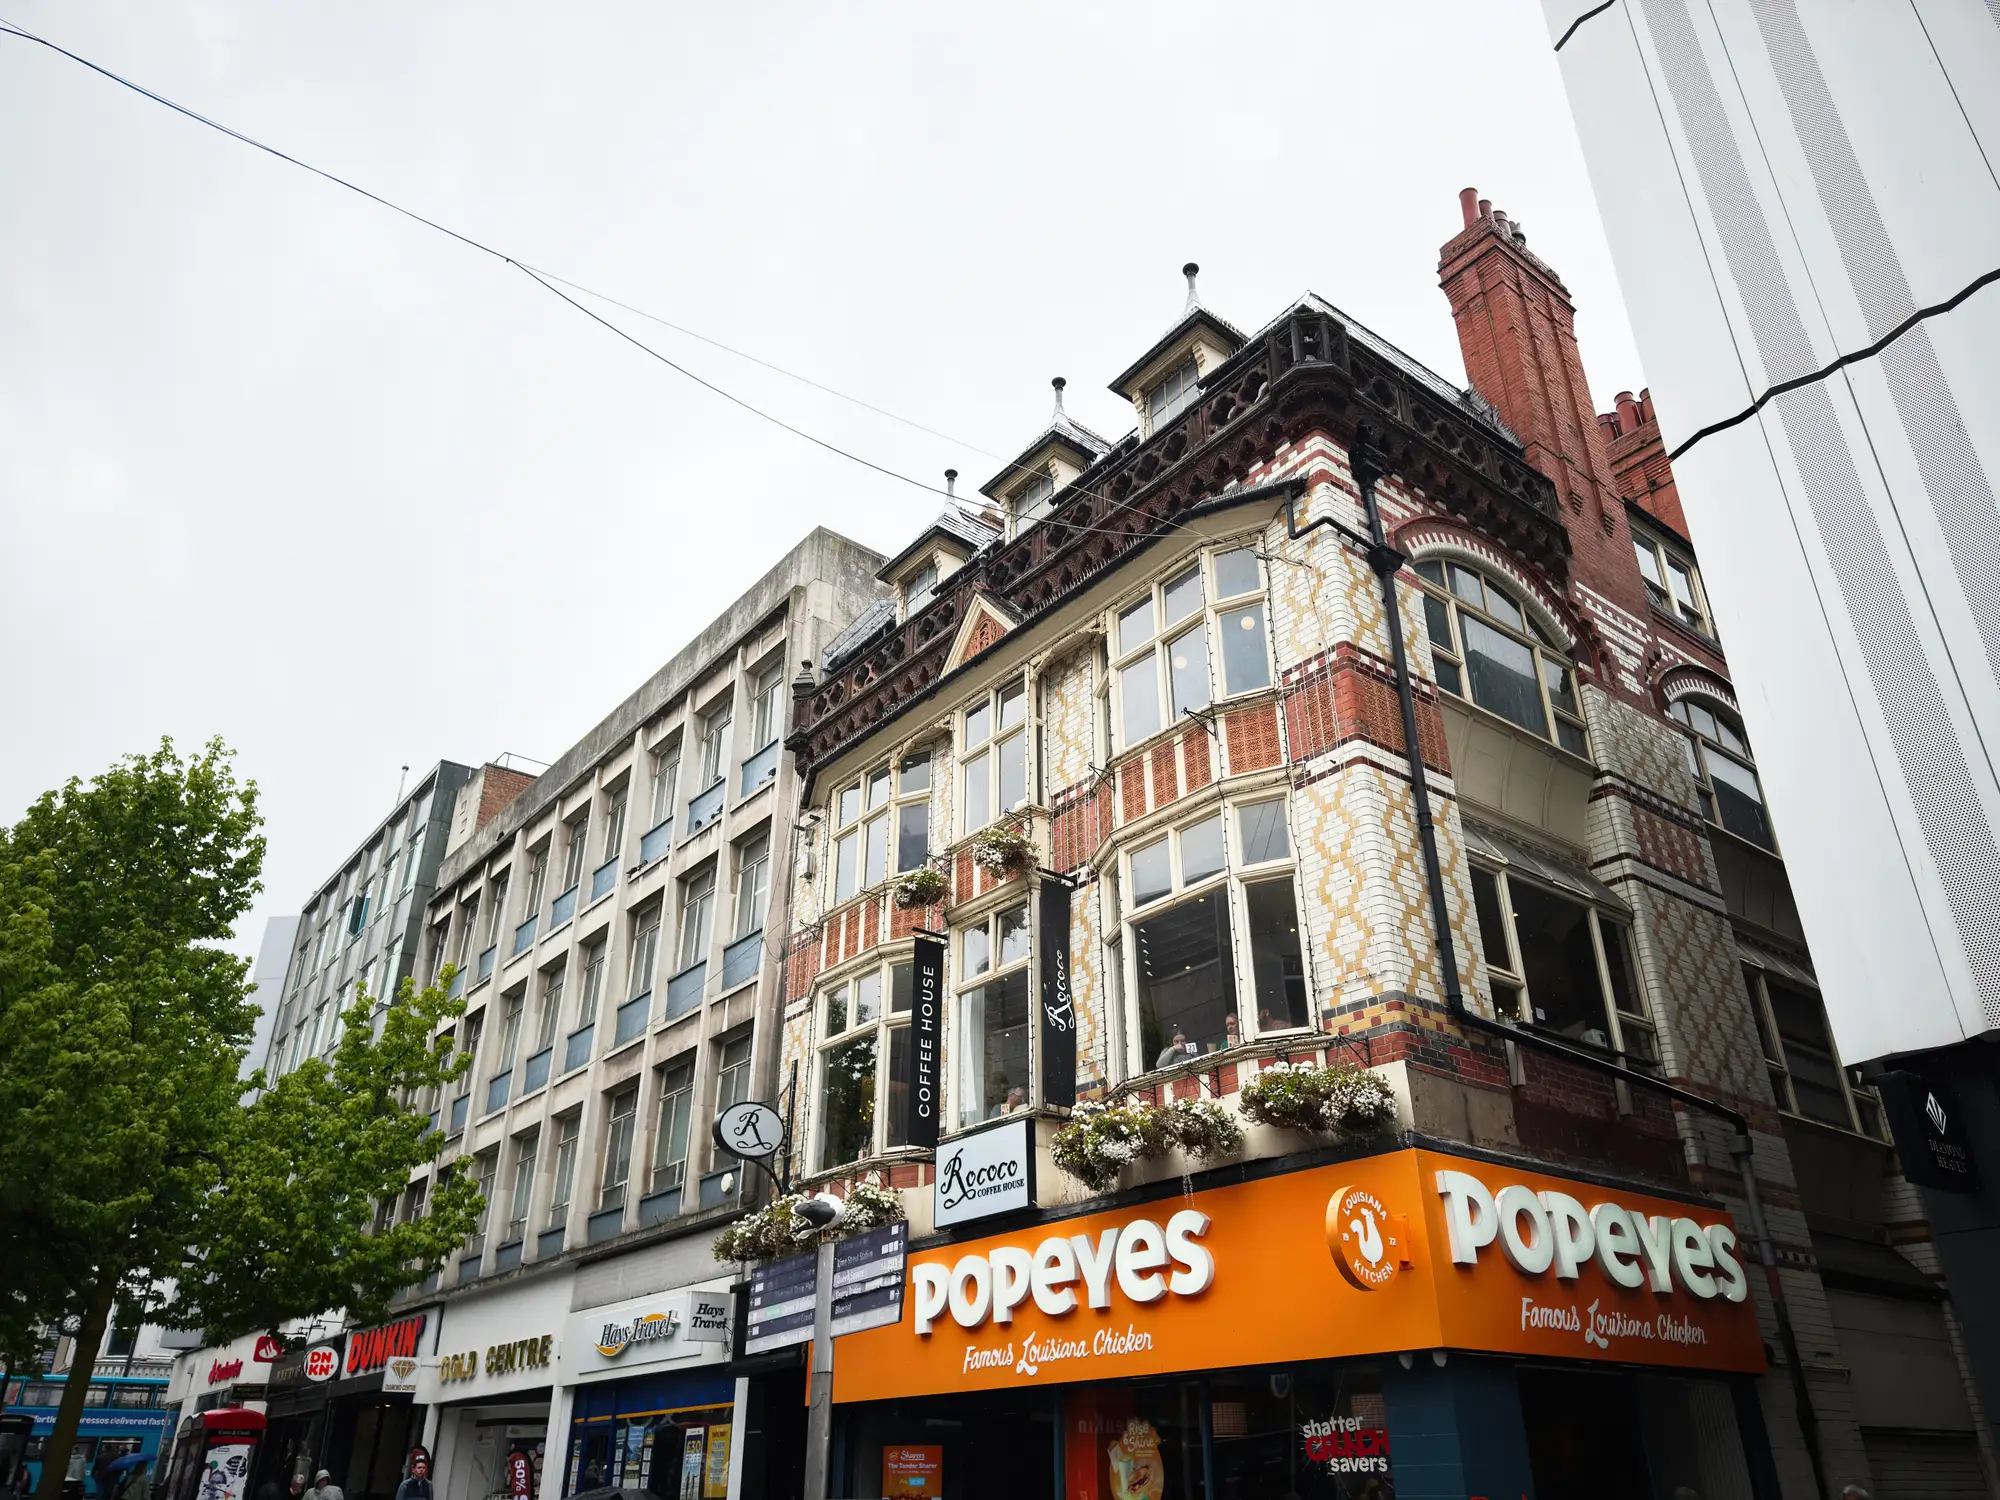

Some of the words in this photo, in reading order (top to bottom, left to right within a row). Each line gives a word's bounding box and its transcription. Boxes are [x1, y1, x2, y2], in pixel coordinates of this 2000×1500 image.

[921, 965, 934, 1032] HOUSE
[1044, 949, 1075, 1032] Rococo
[918, 1038, 932, 1118] COFFEE
[734, 1108, 773, 1150] R
[940, 1147, 1018, 1209] Rococo
[977, 1184, 1002, 1197] COFFEE
[1003, 1178, 1025, 1191] HOUSE
[1342, 1191, 1387, 1221] LOUISIANA
[1354, 1259, 1394, 1283] KITCHEN
[692, 1316, 727, 1329] Travel
[696, 1303, 725, 1318] Hays
[1521, 1297, 1581, 1332] Famous
[1584, 1298, 1656, 1349] Louisiana
[1657, 1314, 1708, 1347] Chicken
[600, 1322, 630, 1346] Hays
[633, 1310, 672, 1340] Travel
[310, 1351, 332, 1363] DN
[438, 1350, 478, 1383] GOLD
[485, 1334, 554, 1375] CENTRE
[963, 1342, 1014, 1374] Famous
[1016, 1331, 1089, 1376] Louisiana
[1093, 1323, 1153, 1356] Chicken
[1127, 1422, 1149, 1436] Rise
[1303, 1415, 1363, 1438] shatter
[685, 1453, 701, 1464] FREE
[1127, 1435, 1155, 1453] Shine
[514, 1459, 526, 1492] 50%
[1330, 1457, 1388, 1473] savers
